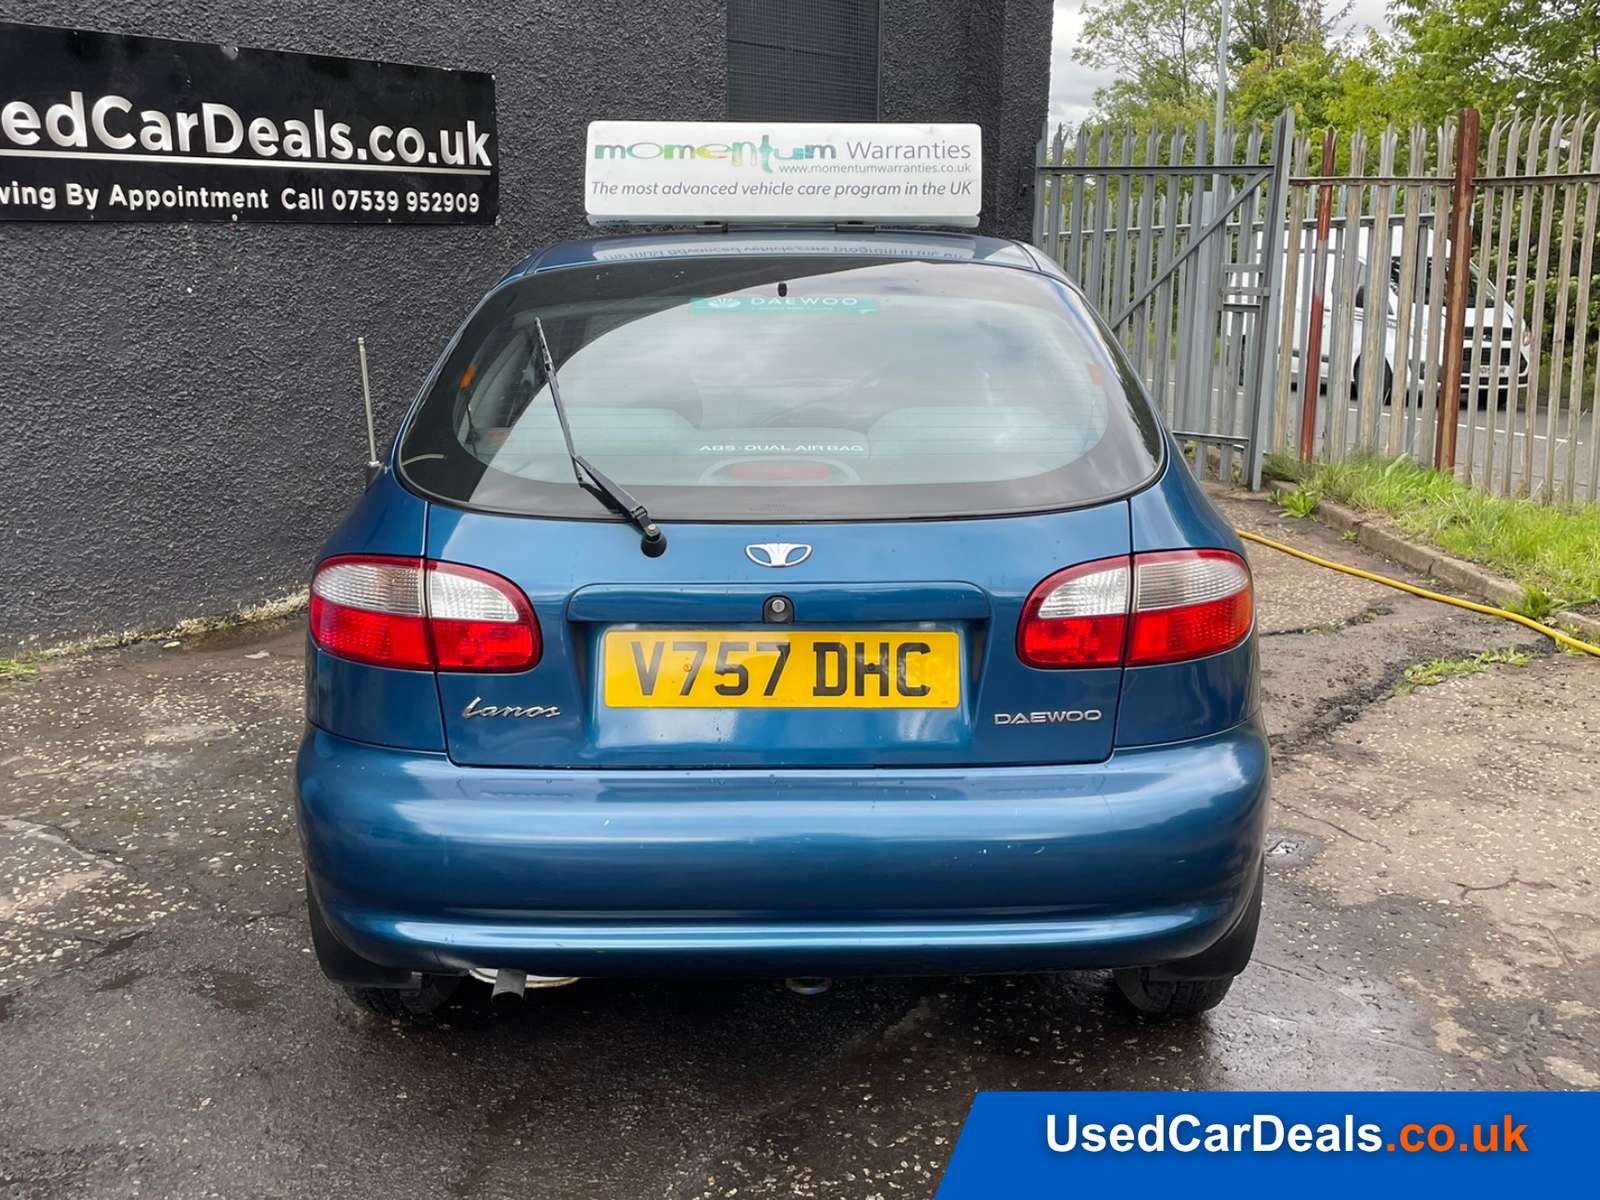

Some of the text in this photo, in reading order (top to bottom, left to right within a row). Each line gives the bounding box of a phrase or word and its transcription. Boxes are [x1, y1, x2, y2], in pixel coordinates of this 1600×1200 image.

[1, 91, 492, 167] edCarDeals.co.uk
[594, 134, 972, 173] momentum Warranties
[778, 162, 972, 174] www.momentumwarranties.co.uk
[66, 183, 99, 210] By
[108, 184, 269, 211] Appointment
[281, 187, 324, 210] Call
[332, 189, 399, 212] 07539
[406, 191, 480, 213] 952909
[591, 181, 972, 198] The most advanced vehicle care program in the UK
[751, 297, 858, 305] DAEWOO
[631, 641, 931, 697] V757 DHC
[994, 709, 1102, 725] DAEWOO
